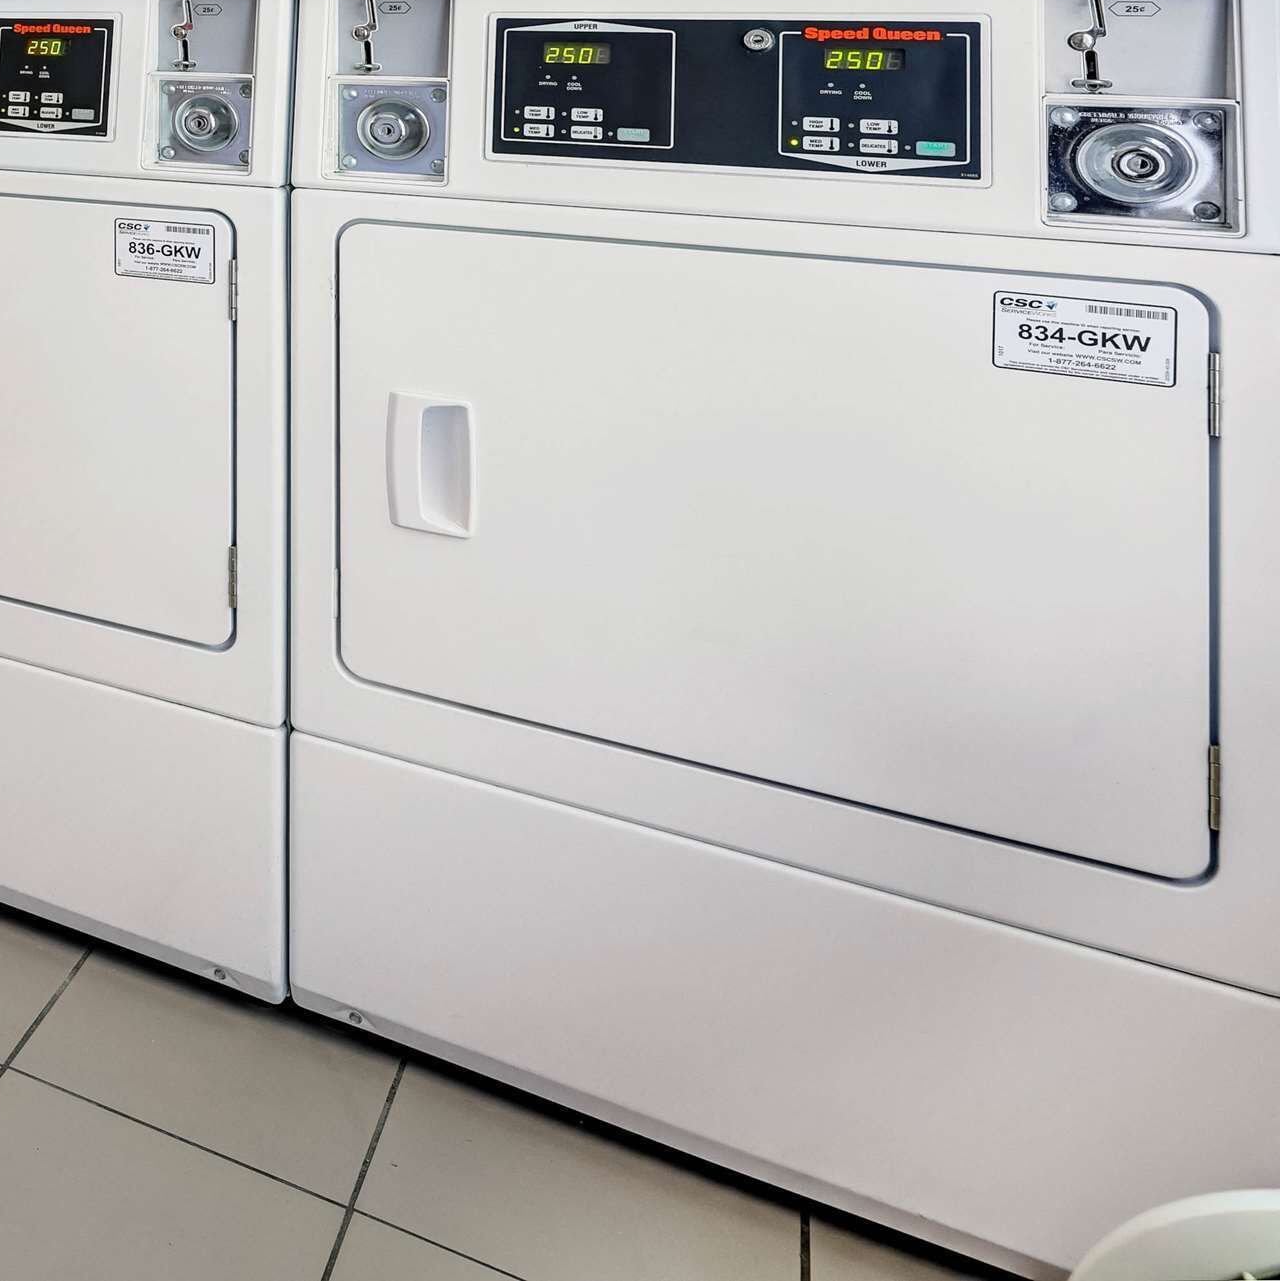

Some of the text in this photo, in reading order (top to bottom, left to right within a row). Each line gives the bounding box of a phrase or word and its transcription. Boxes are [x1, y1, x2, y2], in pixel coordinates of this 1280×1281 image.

[1125, 5, 1145, 13] 25¢
[14, 24, 91, 34] Speed Queen
[805, 27, 941, 42] Speed Queen
[28, 41, 61, 54] 250
[545, 47, 593, 64] 250
[826, 51, 883, 70] 250
[856, 160, 887, 168] LOWER
[128, 242, 201, 259] 836-GKW
[999, 297, 1043, 309] CSC
[1018, 323, 1151, 353] 834-GKW
[1048, 357, 1117, 371] 1-877-264-6622
[1075, 353, 1142, 366] WWW.CSCSW.COM
